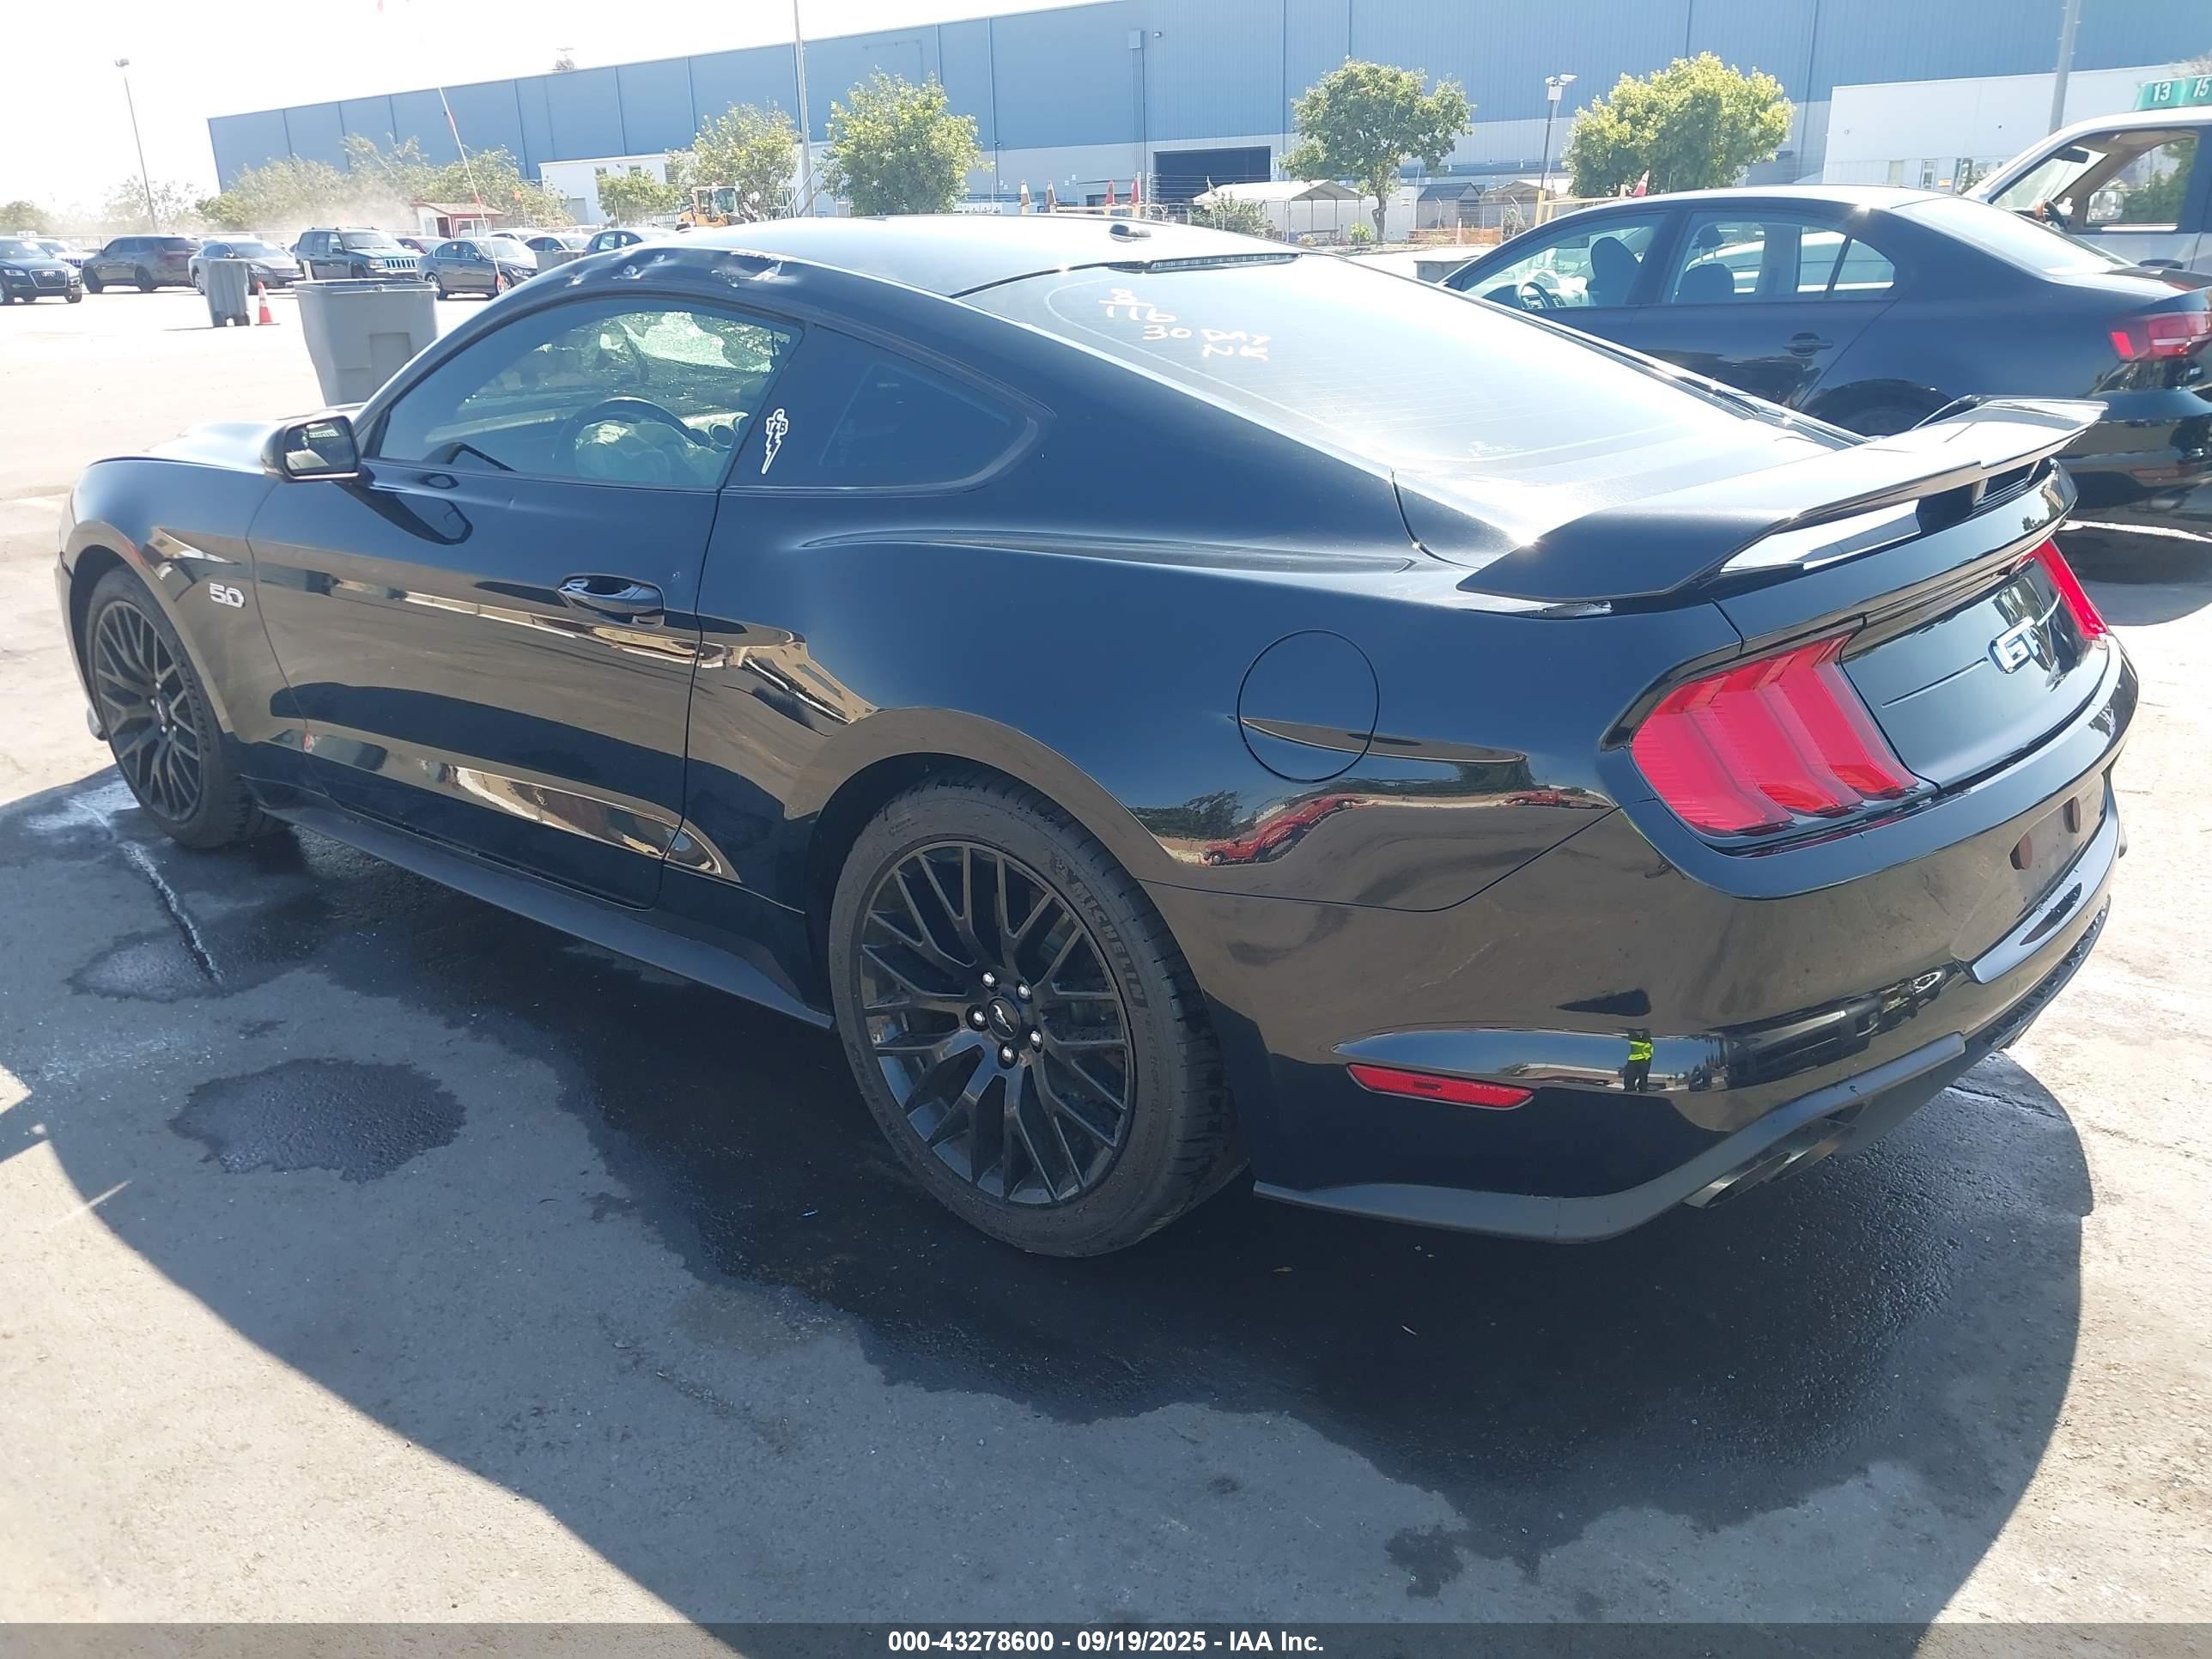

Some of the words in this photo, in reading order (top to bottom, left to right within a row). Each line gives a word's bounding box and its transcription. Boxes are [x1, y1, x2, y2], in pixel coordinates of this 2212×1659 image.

[2154, 82, 2172, 102] 13
[1142, 325, 1193, 340] 30
[1073, 879, 1148, 1008] MICHELIN
